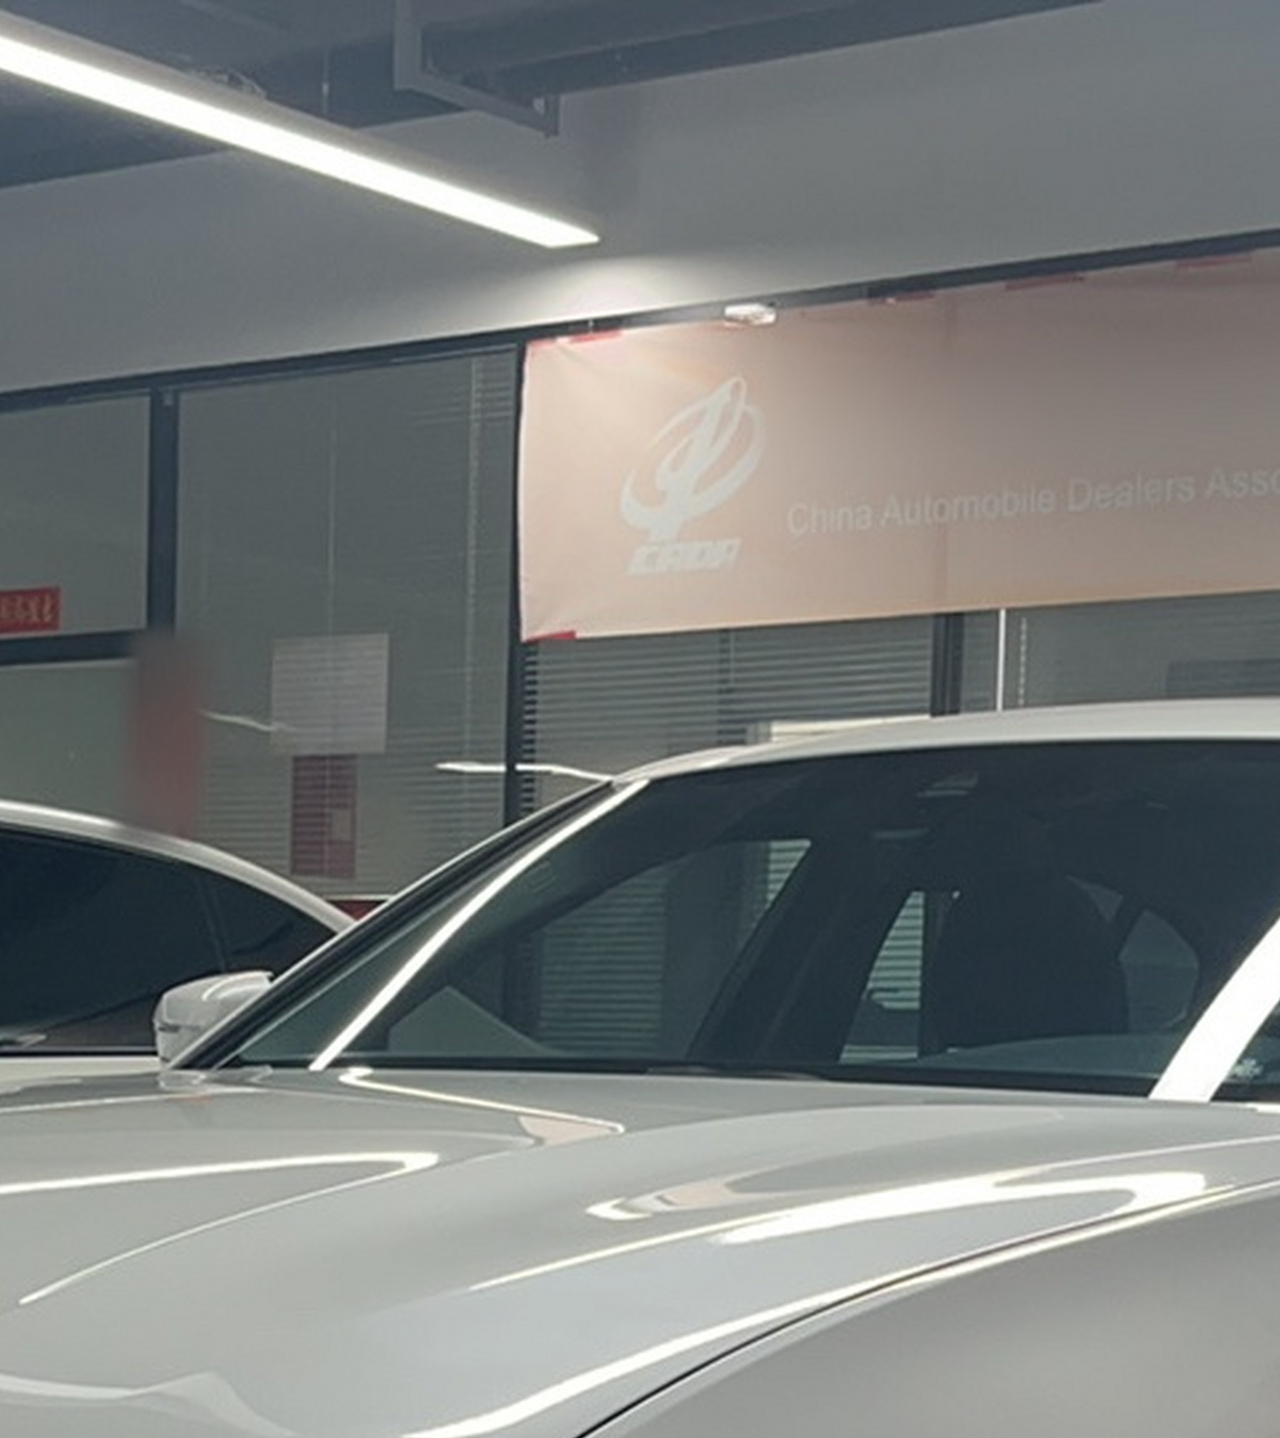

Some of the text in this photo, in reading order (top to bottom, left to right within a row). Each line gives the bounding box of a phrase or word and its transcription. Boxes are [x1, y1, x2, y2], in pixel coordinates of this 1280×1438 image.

[786, 502, 873, 535] China
[879, 485, 1056, 526] Automobile
[1067, 473, 1197, 511] Dealers
